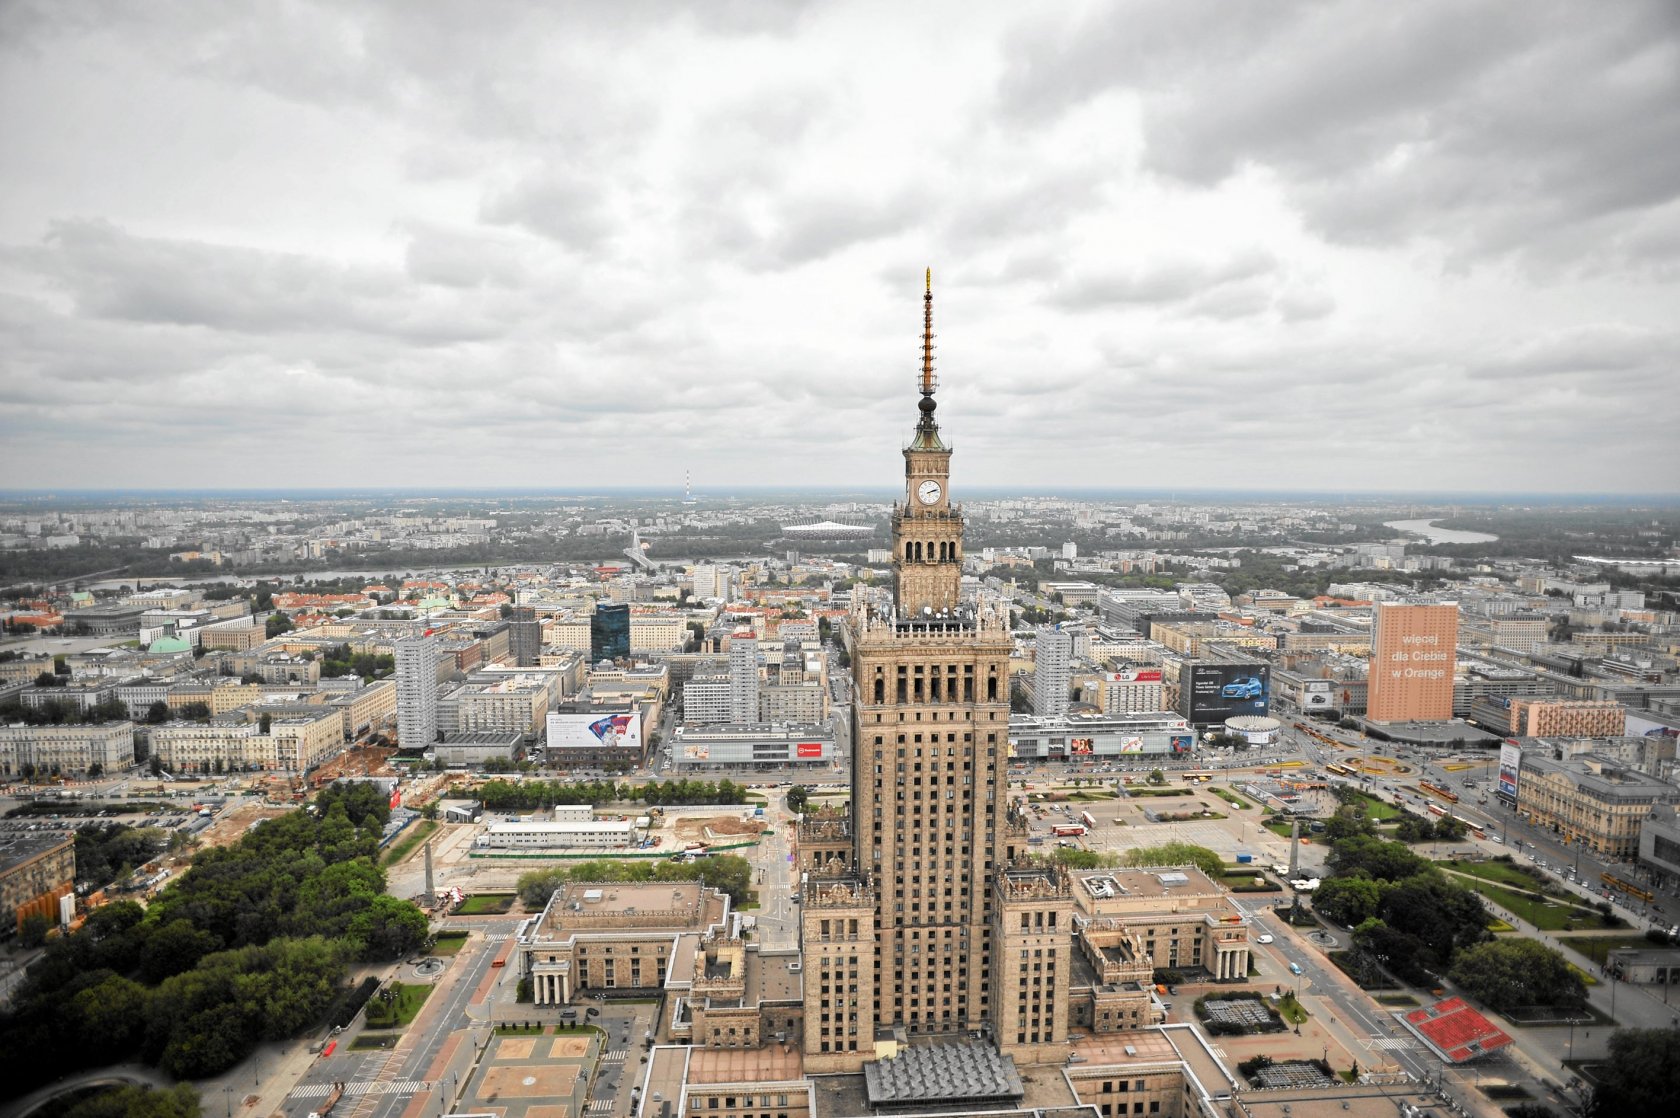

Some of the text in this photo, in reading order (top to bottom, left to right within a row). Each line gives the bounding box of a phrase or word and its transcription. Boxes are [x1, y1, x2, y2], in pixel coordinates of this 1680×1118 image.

[1402, 634, 1438, 646] więcej
[1391, 651, 1447, 661] dla Ciebie
[1392, 668, 1445, 679] w Orange
